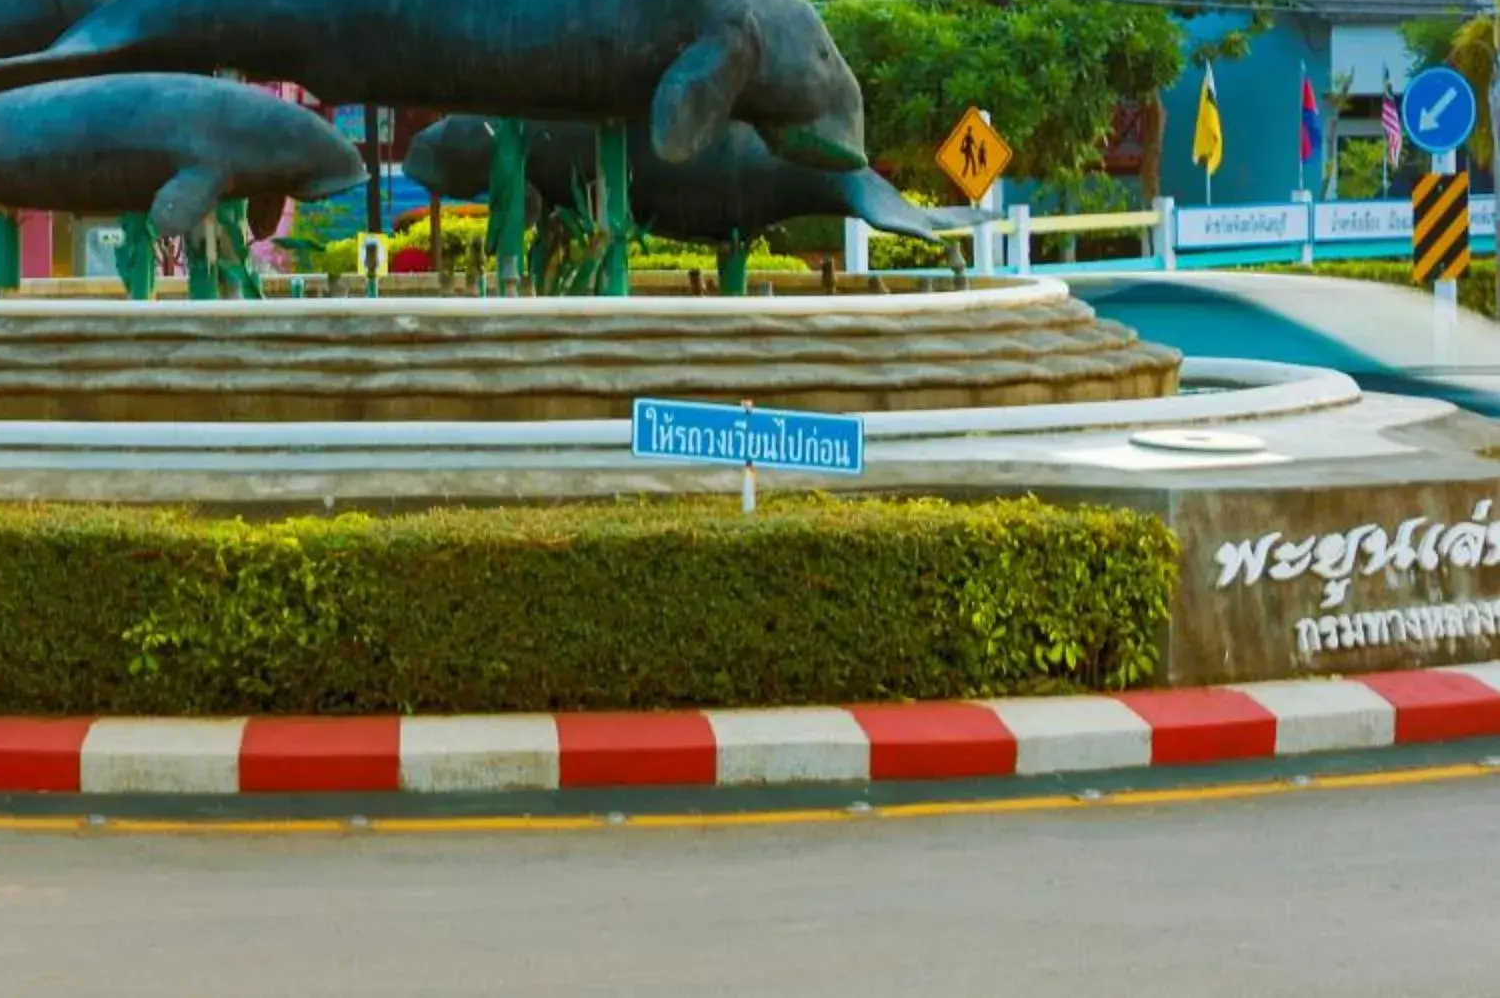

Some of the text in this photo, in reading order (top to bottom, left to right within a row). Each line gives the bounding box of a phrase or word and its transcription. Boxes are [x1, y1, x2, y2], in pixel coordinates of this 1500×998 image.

[645, 406, 850, 466] ให้รถวงเวียนไปก่อน
